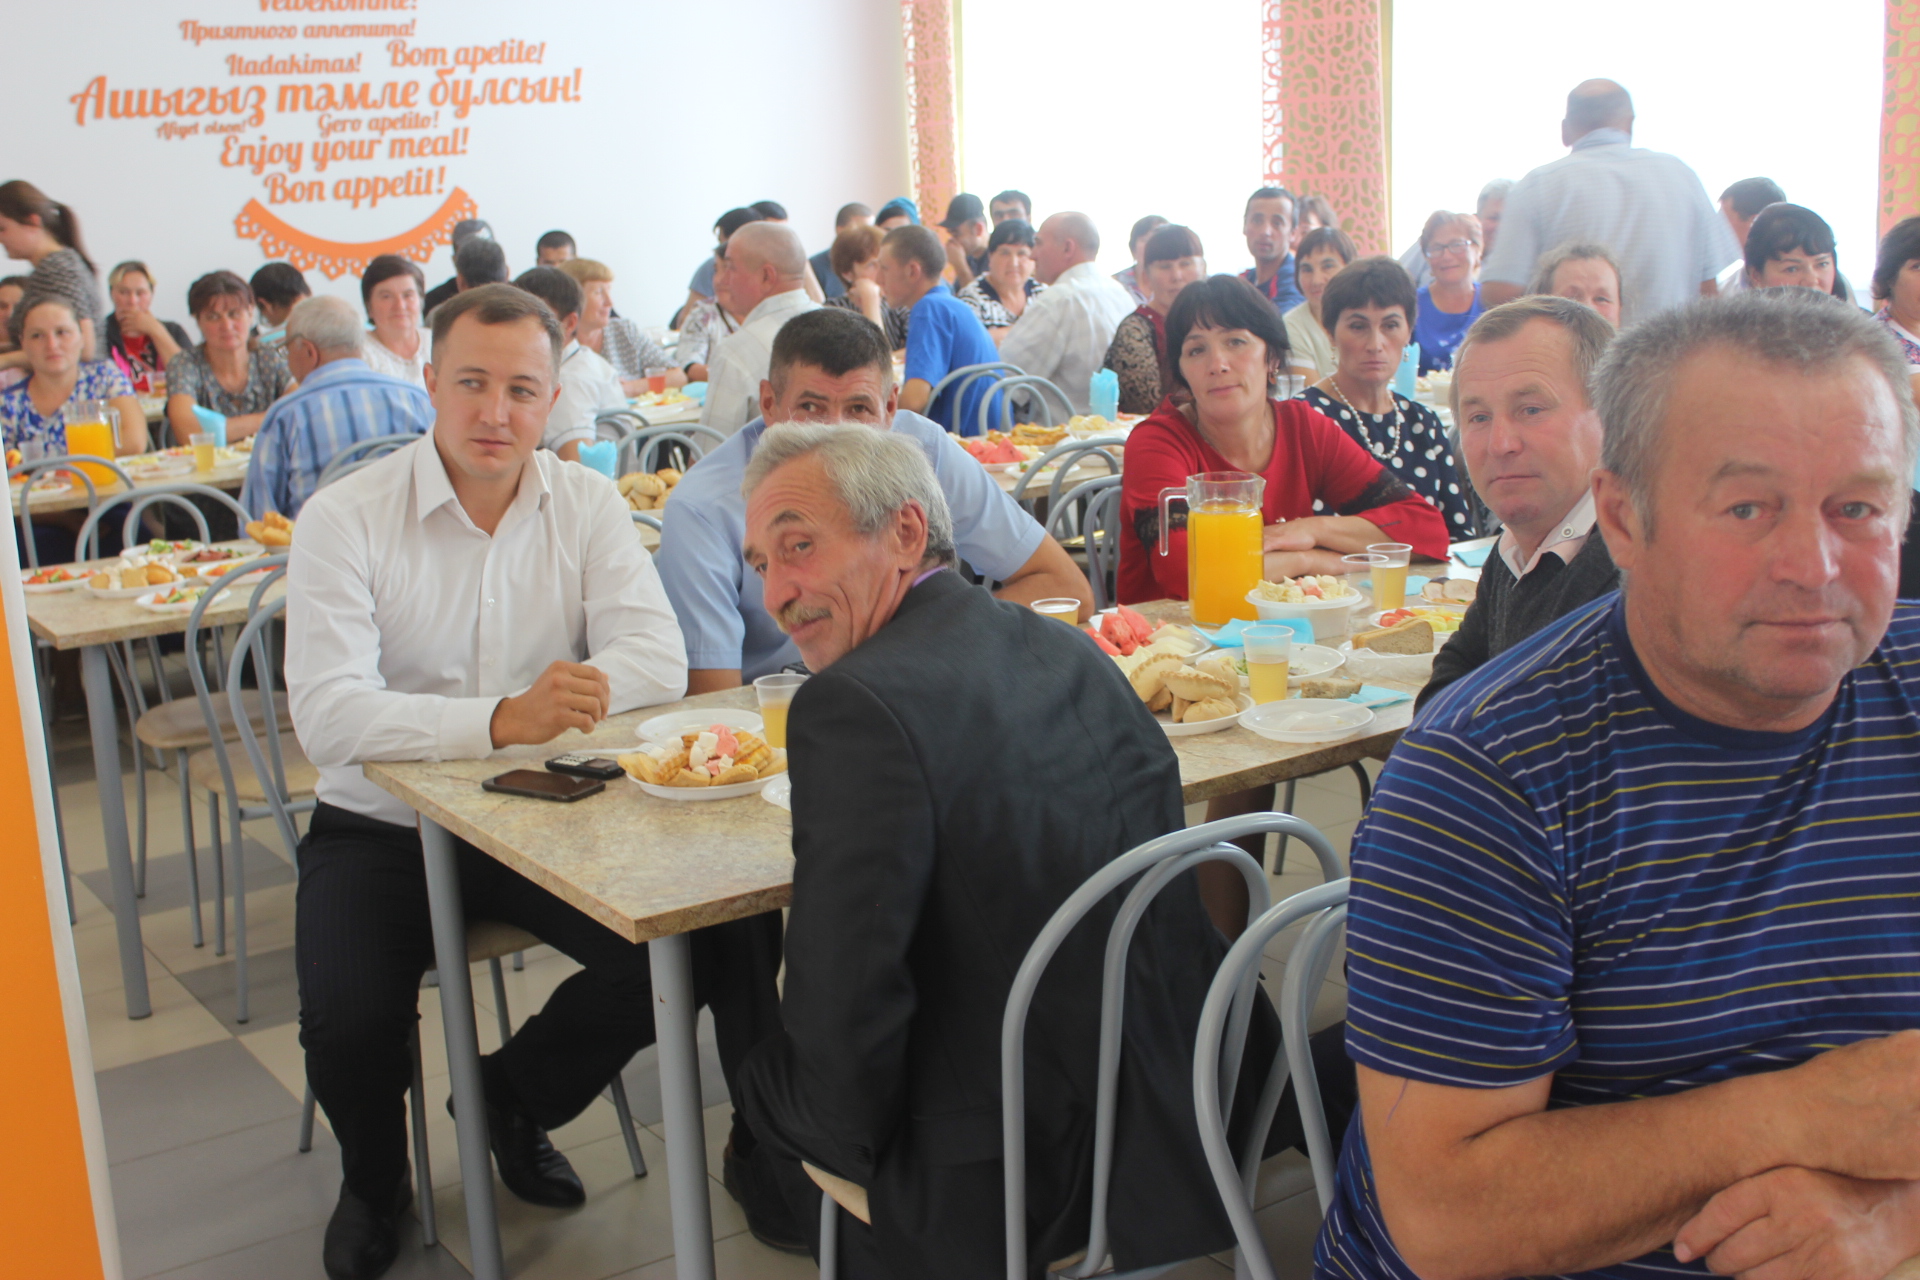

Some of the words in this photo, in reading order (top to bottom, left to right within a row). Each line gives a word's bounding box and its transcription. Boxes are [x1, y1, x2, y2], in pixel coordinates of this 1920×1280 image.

[180, 20, 298, 46] Приятного
[303, 19, 417, 38] аппетита!
[225, 53, 363, 76] Itadakimas!
[387, 39, 449, 67] Bom
[455, 38, 547, 74] apetite!
[70, 75, 267, 127] Ашыгыз
[277, 80, 420, 113] тәмле
[430, 66, 582, 119] булсын!
[318, 113, 363, 138] Gero
[368, 111, 440, 137] apetito!
[219, 134, 304, 176] Enjoy
[312, 139, 383, 172] your
[389, 127, 470, 160] meal!
[263, 172, 327, 205] Bon
[333, 165, 446, 209] appetit!
